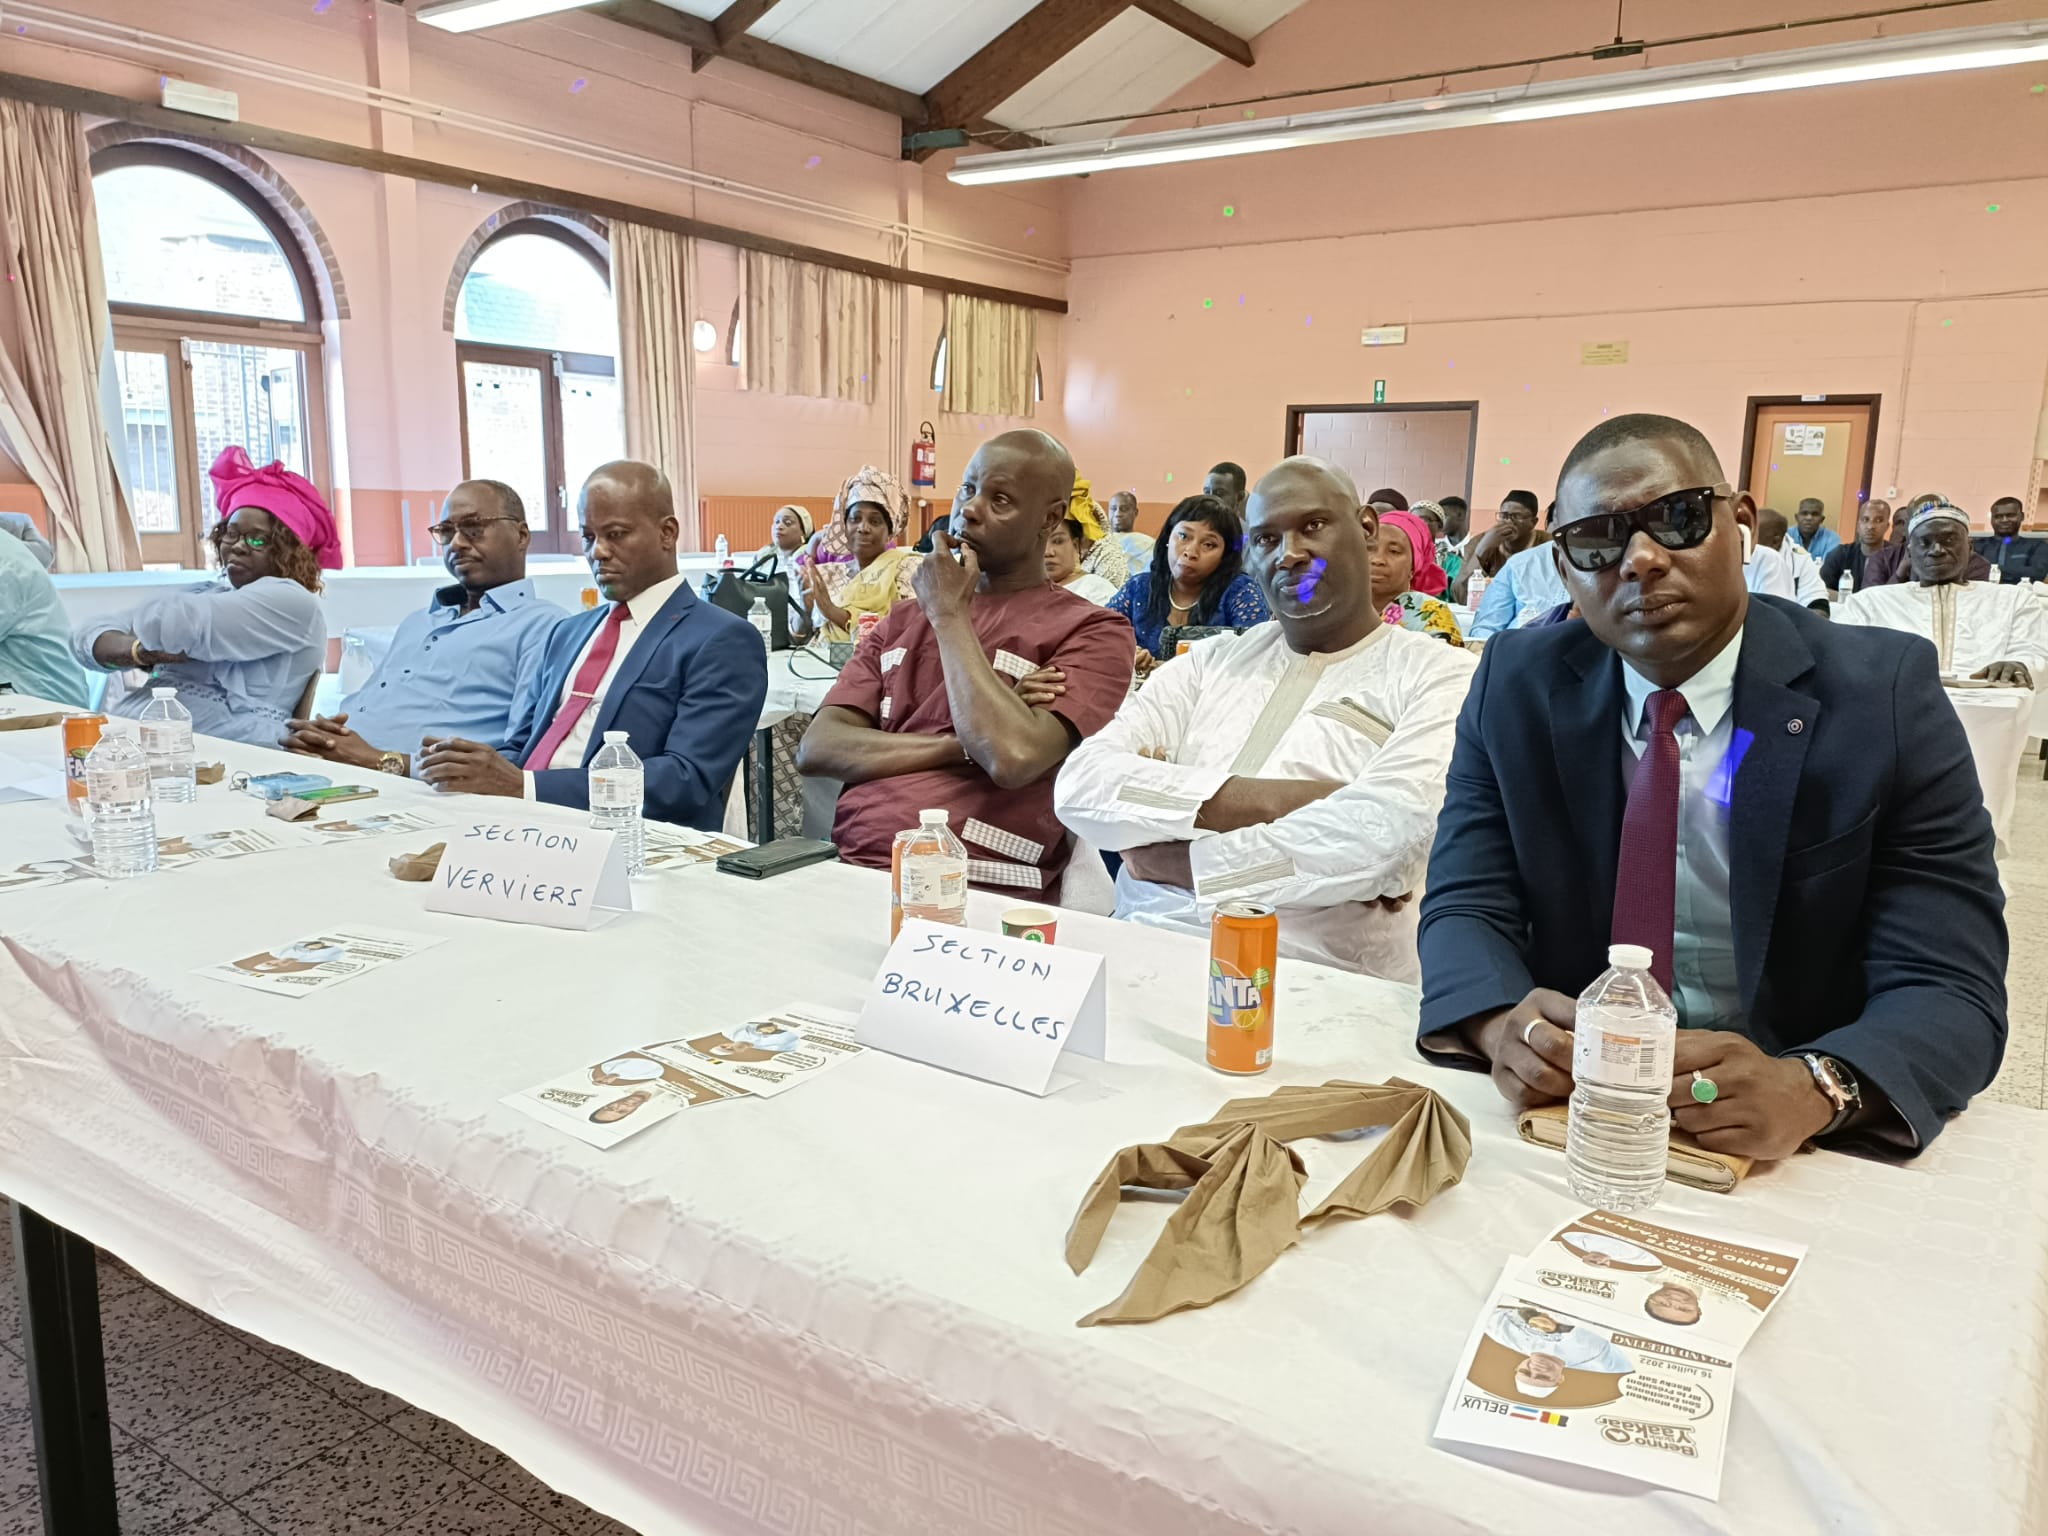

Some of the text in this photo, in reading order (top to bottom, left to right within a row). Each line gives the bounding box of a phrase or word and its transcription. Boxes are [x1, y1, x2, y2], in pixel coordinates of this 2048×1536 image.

[464, 824, 578, 853] SECTION
[913, 934, 1051, 981] SECTION
[1209, 976, 1261, 1008] ANTA
[882, 972, 1065, 1040] BRUXELLES
[1593, 1214, 1659, 1239] YAAKAR
[1645, 1238, 1718, 1263] JE VOTE
[1722, 1254, 1788, 1275] BENNO
[1542, 1270, 1618, 1291] Yaakaar
[1565, 1284, 1611, 1299] Benno
[1615, 1336, 1677, 1356] MEETING
[1640, 1357, 1712, 1379] 16 Juillet 2022
[1626, 1384, 1701, 1409] Son Excellence
[1659, 1379, 1691, 1392] Macky
[1461, 1396, 1509, 1415] BELUX
[1688, 1393, 1701, 1401] Mr
[1600, 1418, 1692, 1443] Yaakaar
[1635, 1437, 1694, 1456] Benno
